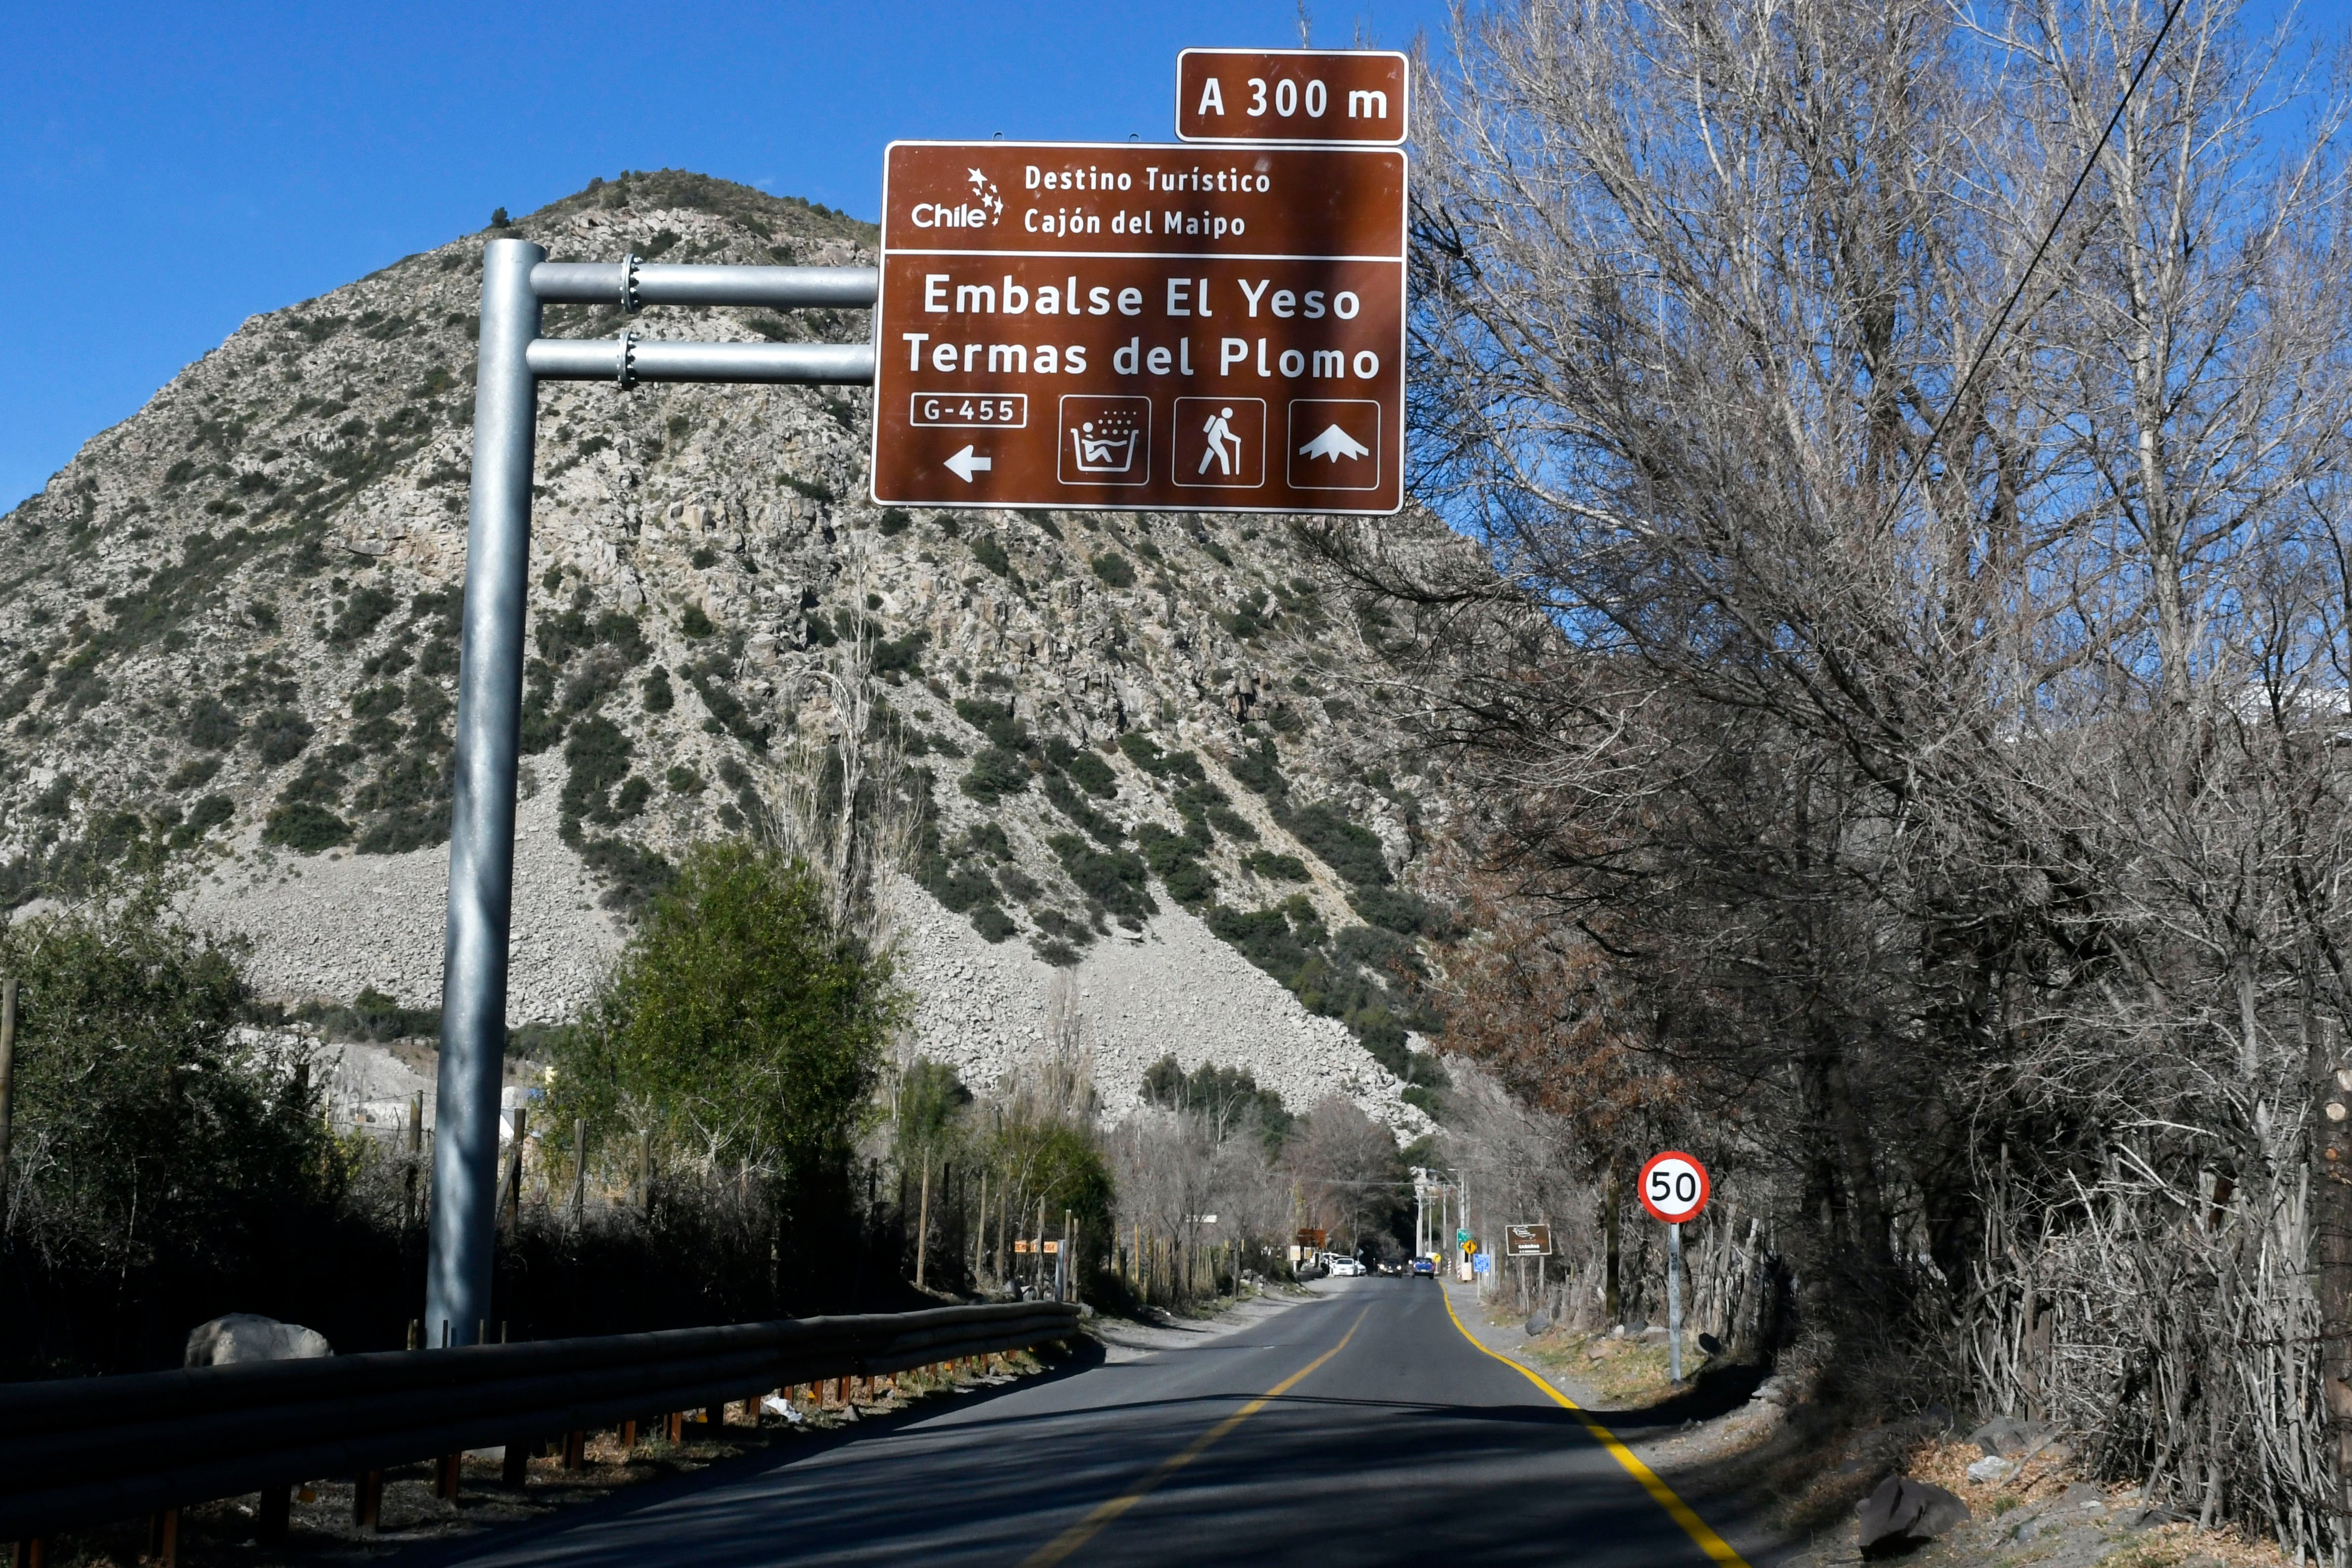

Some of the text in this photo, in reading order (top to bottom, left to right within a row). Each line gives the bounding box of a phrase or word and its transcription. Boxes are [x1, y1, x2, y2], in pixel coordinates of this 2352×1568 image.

[1198, 78, 1387, 119] A 300 m
[1025, 166, 1270, 192] Destino Turístico
[911, 203, 986, 228] Chile
[1024, 207, 1245, 239] Cajón del Maipo
[924, 274, 1360, 320] Embalse El Yeso
[903, 333, 1379, 379] Termas del Plomo
[924, 400, 1013, 421] G-455
[1652, 1172, 1696, 1202] 50
